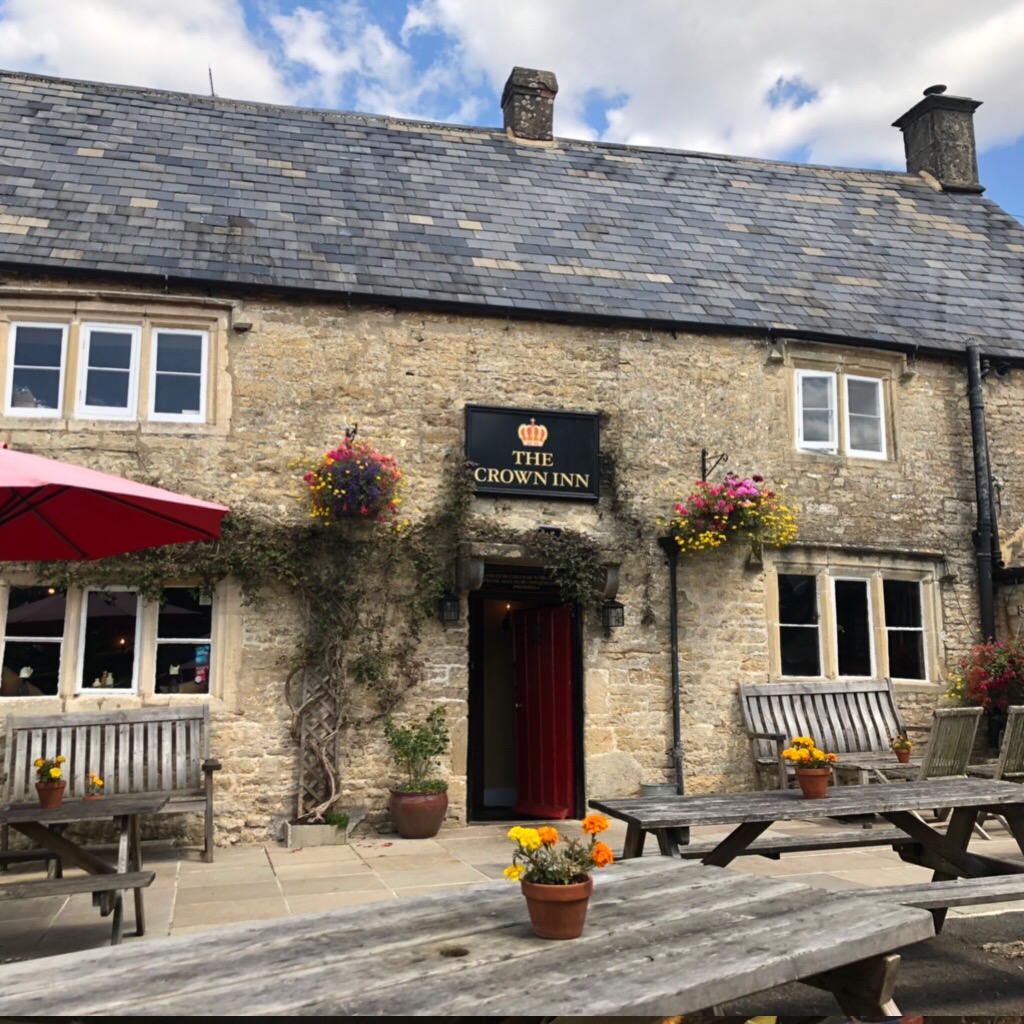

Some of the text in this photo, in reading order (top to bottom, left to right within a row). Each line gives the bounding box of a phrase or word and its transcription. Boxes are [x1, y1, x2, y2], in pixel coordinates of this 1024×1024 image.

[512, 450, 554, 467] THE
[474, 467, 589, 488] CROWN INN
